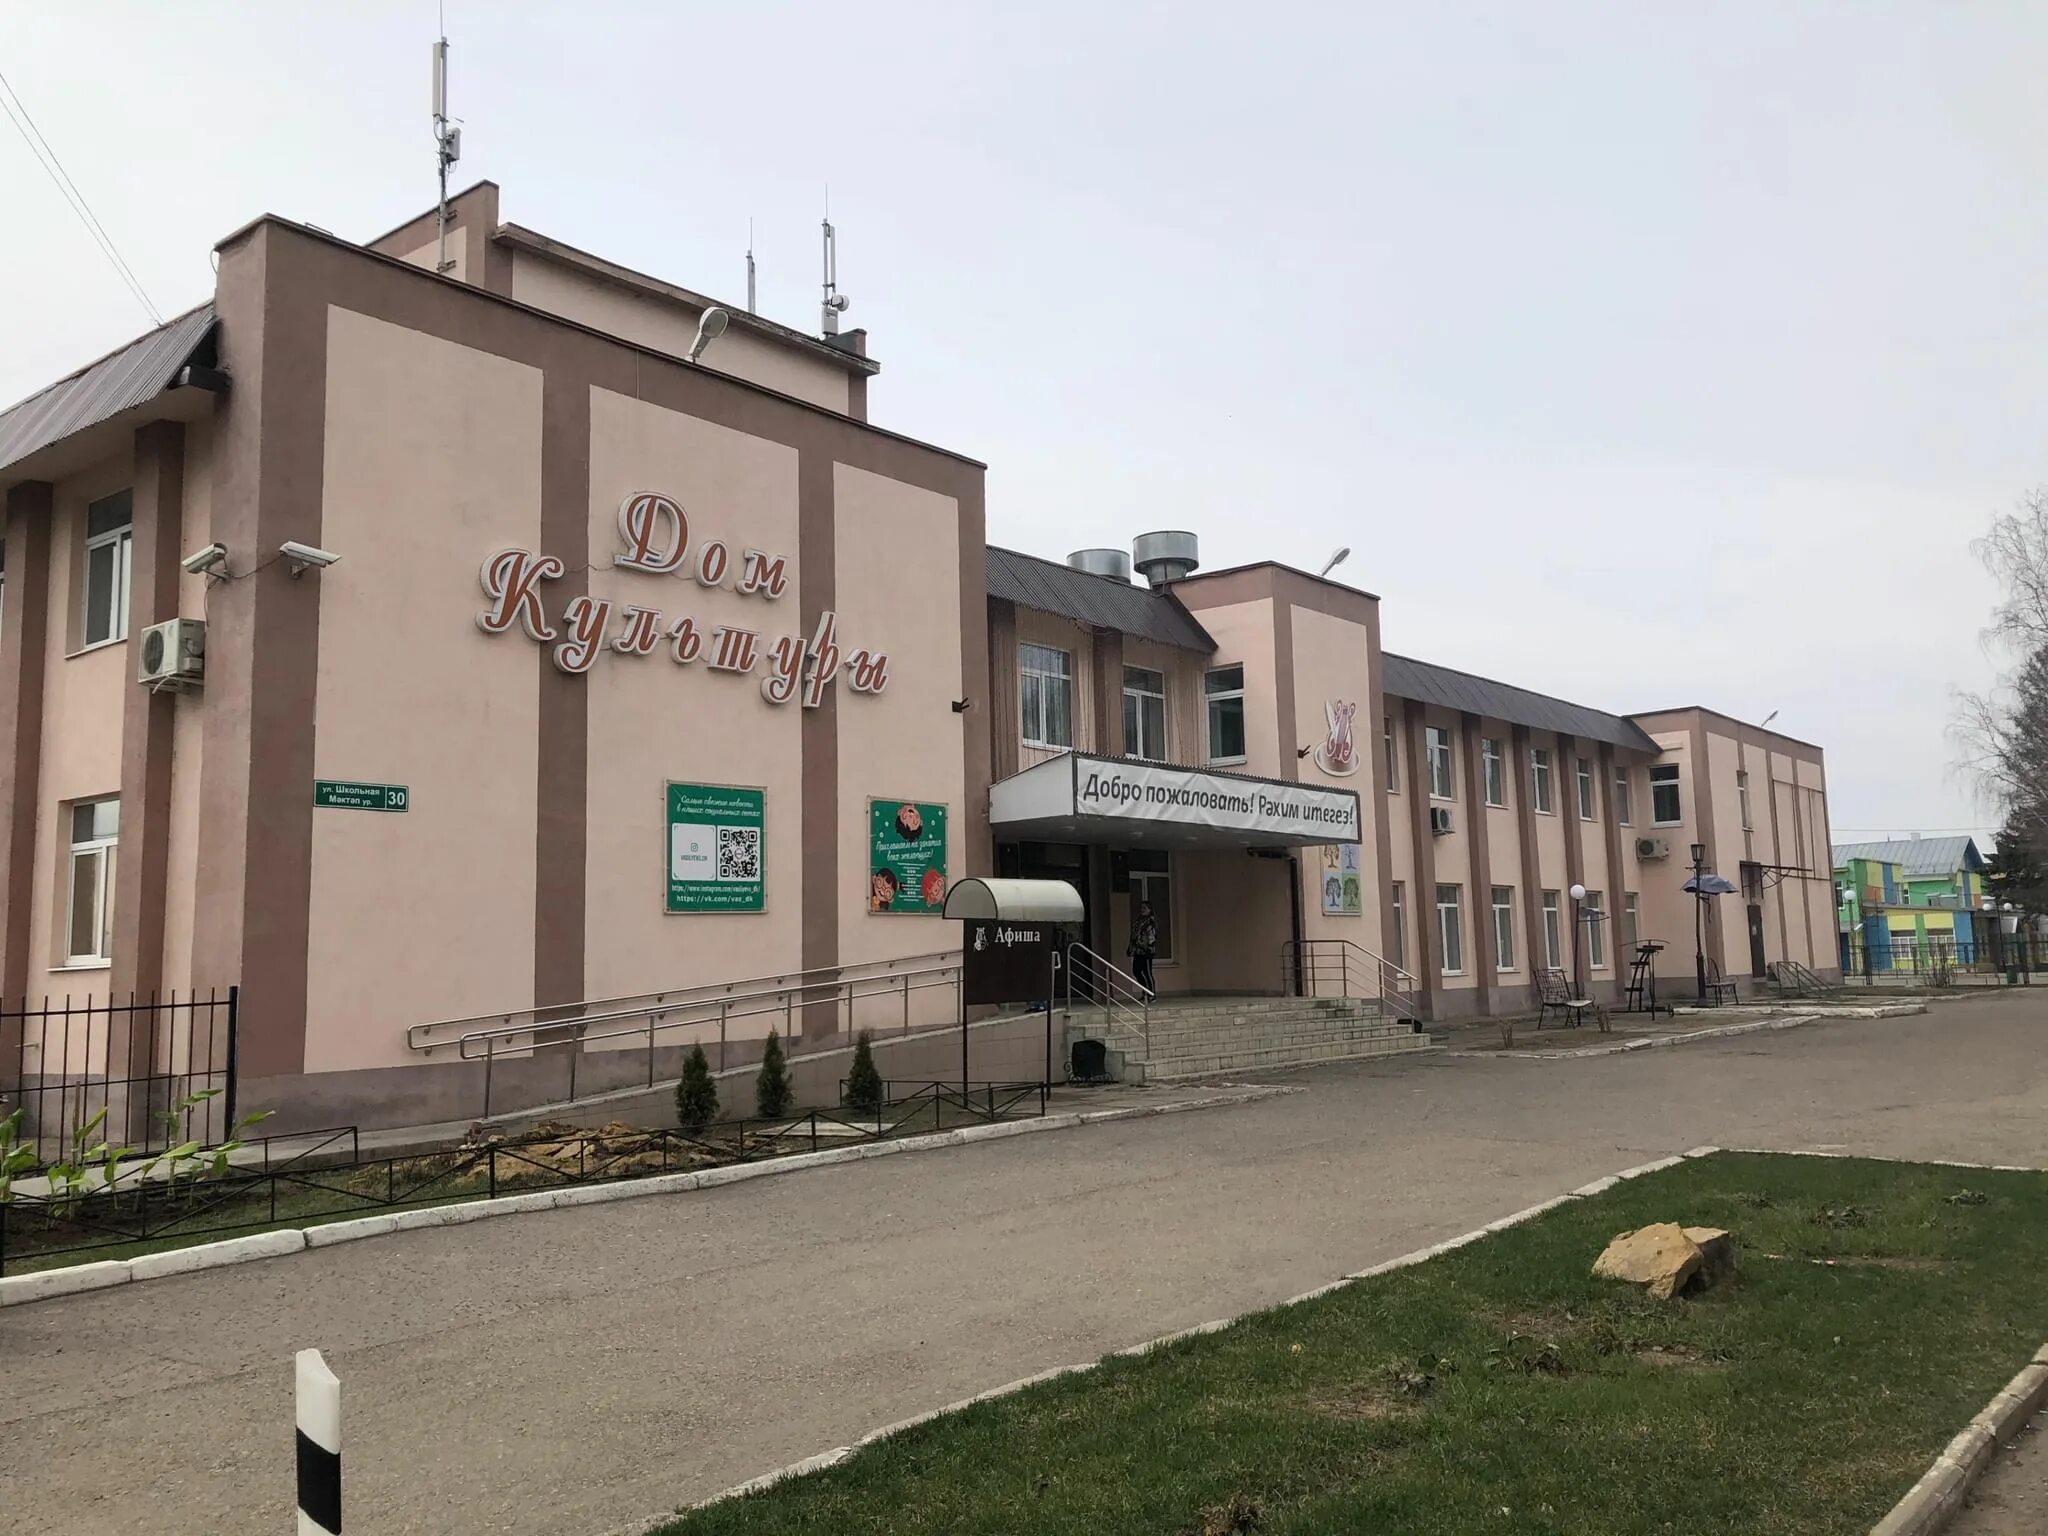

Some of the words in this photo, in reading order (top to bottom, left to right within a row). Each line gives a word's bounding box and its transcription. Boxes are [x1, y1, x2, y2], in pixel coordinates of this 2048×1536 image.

[613, 491, 789, 600] Дом
[477, 547, 889, 708] Культуры
[322, 786, 333, 794] ул.
[336, 785, 380, 796] Школьная
[388, 791, 405, 805] 30
[1083, 774, 1141, 806] Добро
[1146, 785, 1255, 814] пожаловать!
[1258, 795, 1299, 819] Рәхим
[1303, 805, 1354, 825] итегез!
[994, 927, 1041, 948] Афиша
